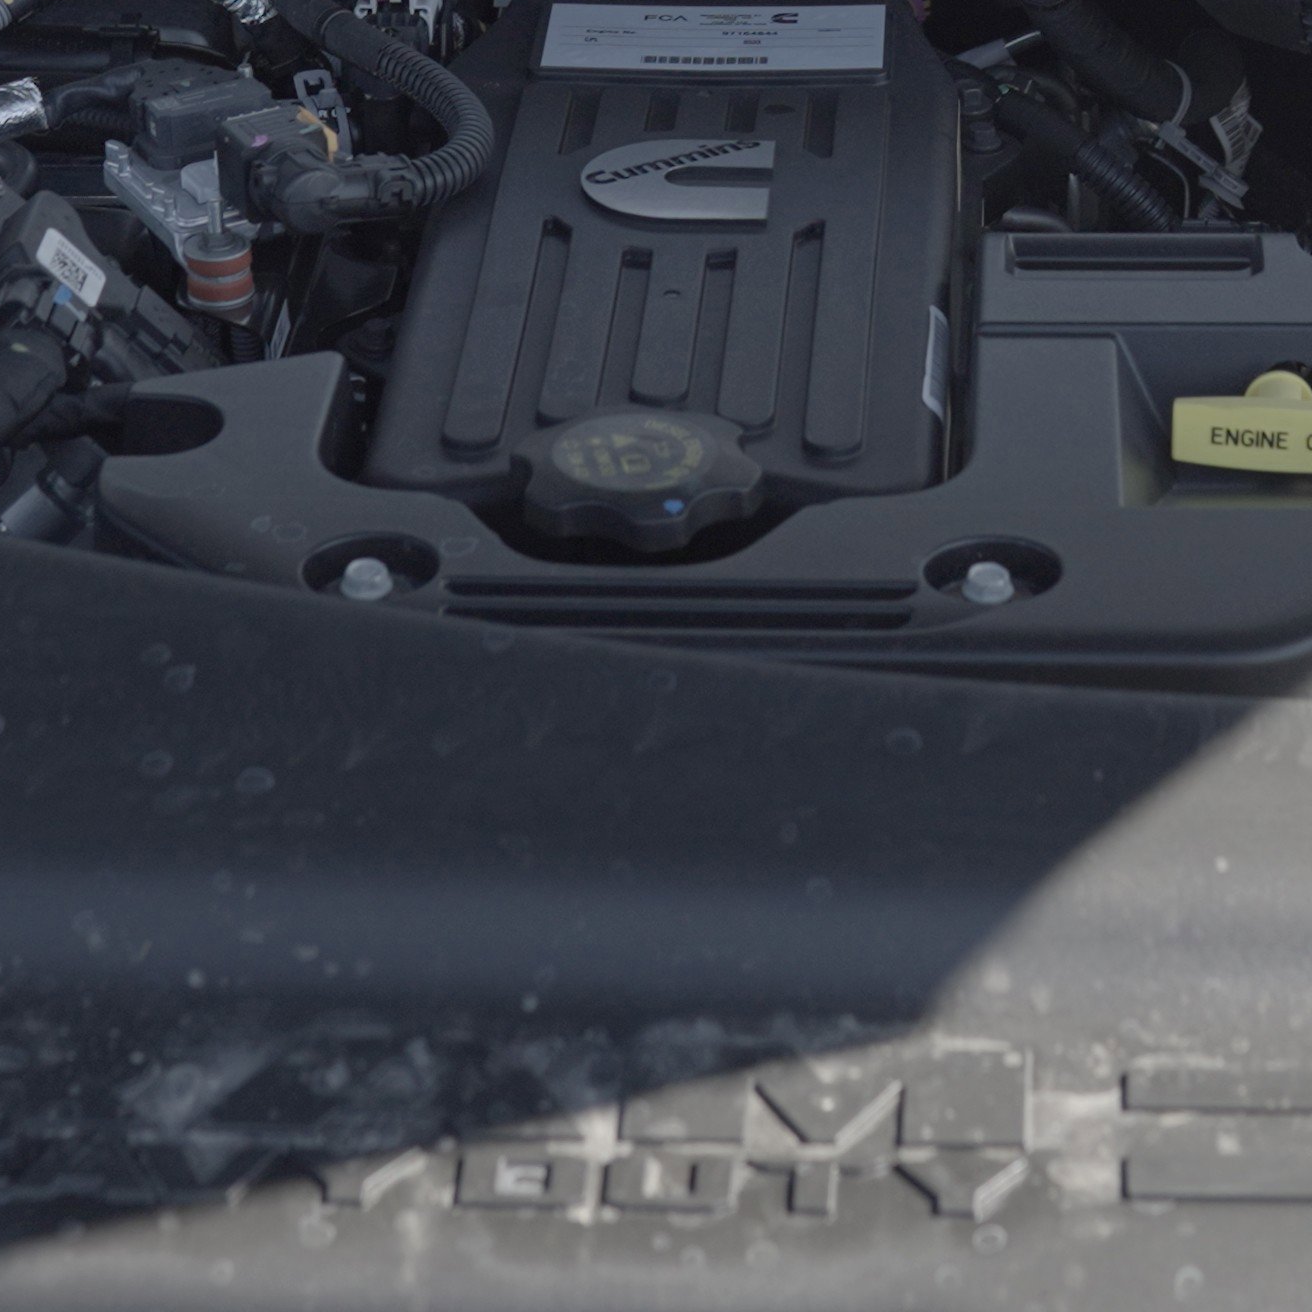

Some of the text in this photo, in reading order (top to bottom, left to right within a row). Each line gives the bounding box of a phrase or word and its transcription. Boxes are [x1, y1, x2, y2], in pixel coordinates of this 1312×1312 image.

[584, 139, 762, 186] Cummins
[1210, 426, 1289, 450] ENGINE
[452, 1142, 1029, 1222] DUTY
